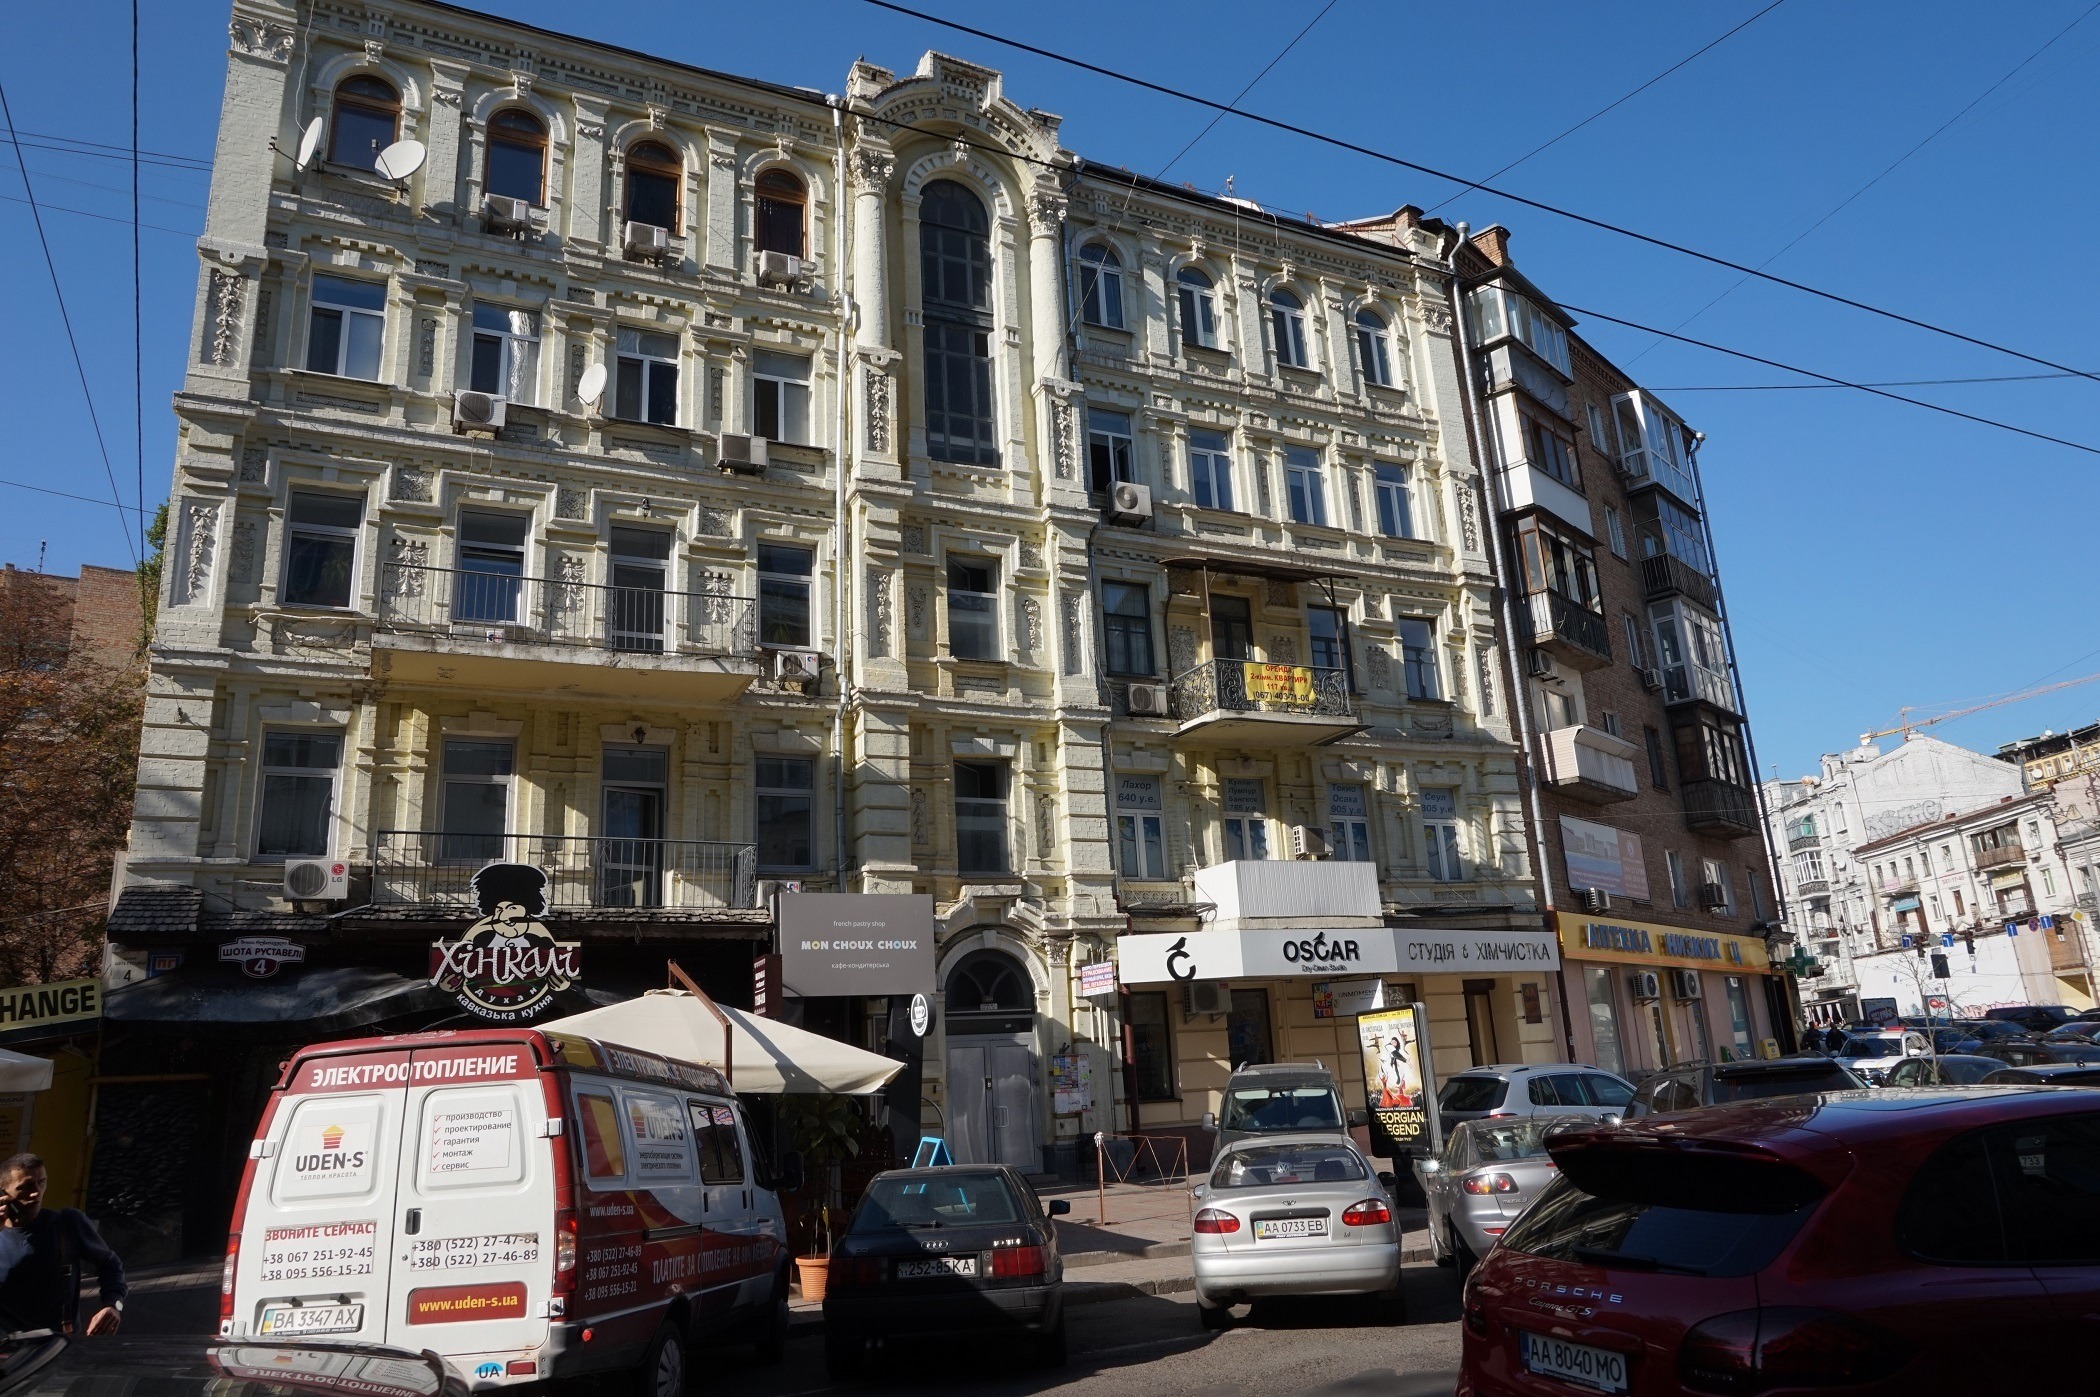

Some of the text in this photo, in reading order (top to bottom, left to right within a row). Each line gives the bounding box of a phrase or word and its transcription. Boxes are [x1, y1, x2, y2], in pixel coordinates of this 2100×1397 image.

[1266, 664, 1292, 673] ОРЕНДА
[1122, 780, 1152, 791] Лахор
[1332, 784, 1357, 793] Токио
[1118, 792, 1136, 802] 640
[1228, 795, 1259, 803] Бангкок
[1332, 794, 1358, 803] Осака
[1424, 792, 1447, 802] Сеул
[1331, 805, 1347, 814] 905
[853, 920, 871, 928] pastry
[871, 920, 886, 928] shop
[801, 940, 918, 950] MON CHOUX CHOUX
[1587, 922, 1653, 954] АПТЕКА
[1664, 932, 1722, 960] НИЗКИХ
[223, 947, 303, 958] ШОТА РУСТАВЕЛІ
[1408, 942, 1455, 963] СТУДІЯ
[1475, 942, 1551, 961] ХІМЧИСТКА
[253, 959, 267, 974] 4
[831, 961, 890, 970] кафе-кондитерська
[123, 969, 132, 982] 4
[456, 992, 554, 1020] кавказька кухня
[311, 1055, 518, 1087] ЭЛЕКТРООТОПЛЕНИЕ
[445, 1110, 503, 1122] производство
[1374, 1111, 1425, 1123] GEORGIAN
[444, 1122, 512, 1134] проектирование
[1382, 1124, 1420, 1135] LEGEND
[443, 1136, 480, 1146] гарантия
[442, 1149, 474, 1158] монтаж
[295, 1151, 364, 1173] UDEN-S
[441, 1161, 470, 1172] сервис
[329, 1171, 357, 1179] КРАСОТА
[589, 1203, 634, 1217] www.uden-s.ua
[265, 1221, 378, 1241] ЗВОНИТЕ СЕЙЧАС!
[1264, 1220, 1323, 1233] AA 0733 EB
[412, 1241, 441, 1251] +380
[446, 1237, 479, 1251] (522)
[263, 1246, 373, 1264] +38 067 251-92-45
[411, 1249, 538, 1269] +380 (522) 27-46-89
[586, 1245, 642, 1263] +380 (522) 27-46-89
[261, 1263, 371, 1281] +38 095 556-15-21
[585, 1262, 638, 1281] +38 067 251-92-45
[653, 1255, 685, 1284] ПЛАТИТЕ
[687, 1254, 695, 1275] ЗА
[584, 1281, 637, 1301] +38 095 556-15-21
[1514, 1277, 1623, 1304] PORSCHE
[419, 1295, 518, 1312] www.uden-s.ua
[1529, 1296, 1593, 1316] Cayenne GTS
[274, 1308, 357, 1329] BA 3347 AX
[1530, 1338, 1551, 1366] AA
[1554, 1344, 1593, 1375] 8040
[1595, 1357, 1622, 1383] MO
[478, 1364, 500, 1379] UA
